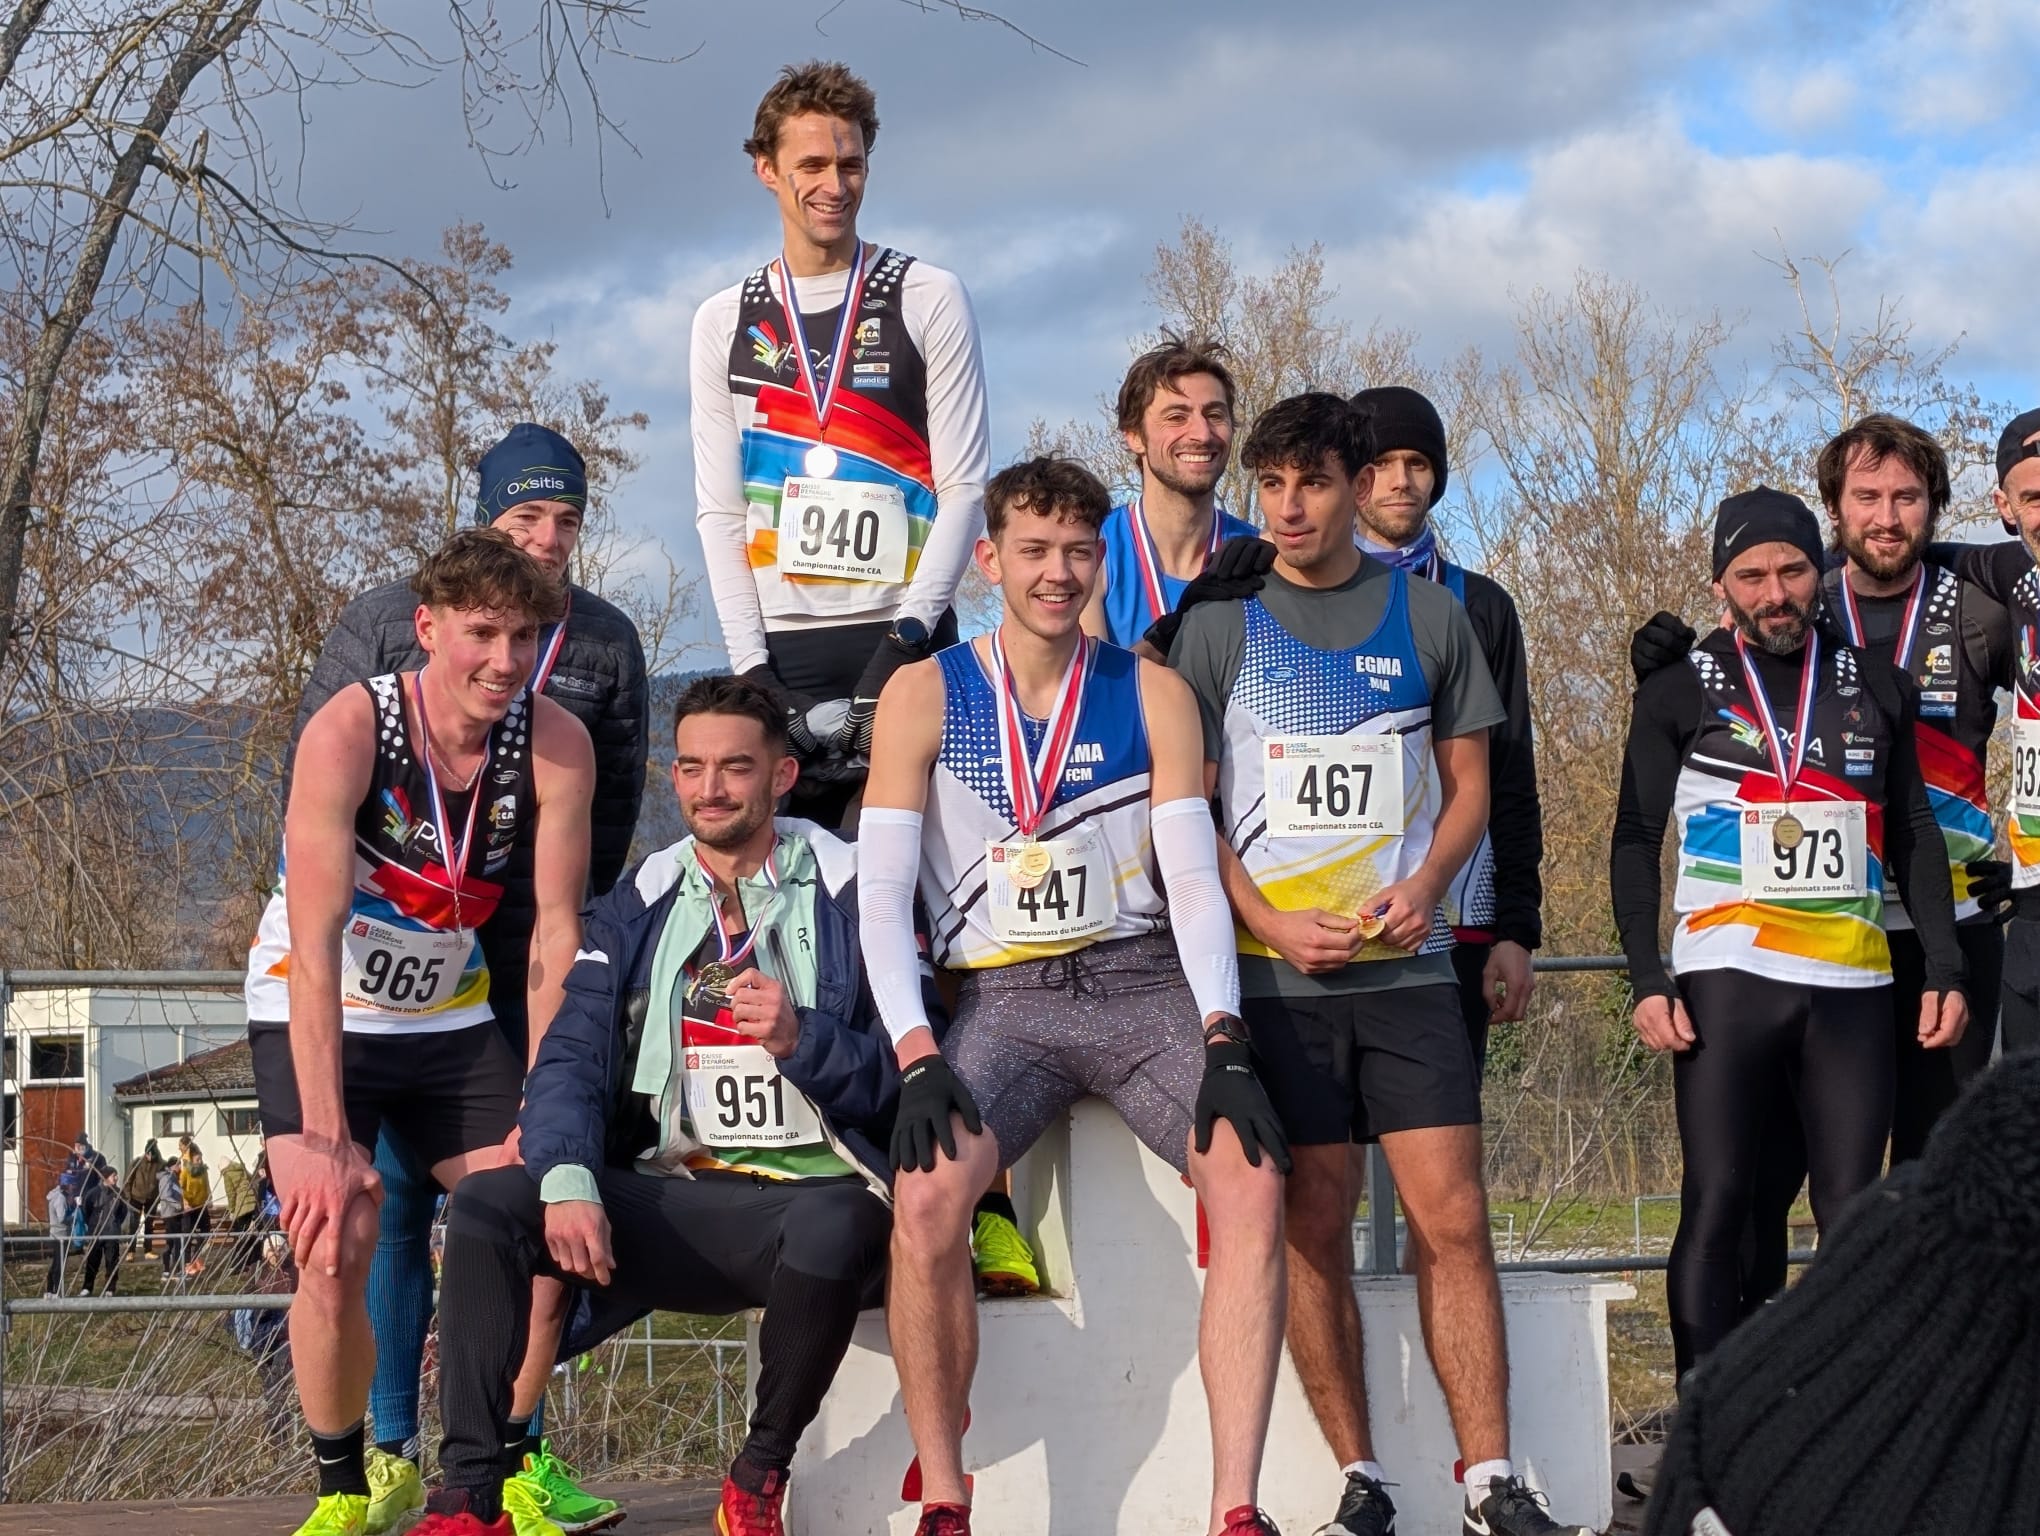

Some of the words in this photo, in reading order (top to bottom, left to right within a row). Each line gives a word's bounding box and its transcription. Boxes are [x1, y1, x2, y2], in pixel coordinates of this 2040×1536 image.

[800, 505, 880, 562] 940
[792, 560, 845, 571] Championnats
[846, 566, 866, 574] zone
[867, 567, 882, 575] CEA
[1355, 655, 1403, 677] EGMA
[1369, 676, 1391, 692] MIA
[1070, 743, 1104, 763] MA
[1065, 767, 1093, 782] FCM
[1296, 763, 1373, 817] 467
[1288, 822, 1346, 833] Championnats
[1347, 822, 1367, 830] zone
[1369, 821, 1384, 829] CEA
[1773, 828, 1844, 880] 973
[1017, 865, 1087, 922] 447
[1763, 884, 1821, 893] Championnats
[1008, 929, 1058, 938] Championnats
[1059, 926, 1070, 935] du
[1071, 919, 1103, 932] Haut-Rhin
[360, 949, 445, 1003] 965
[345, 992, 402, 1013] Championnats
[403, 1006, 421, 1014] zone
[715, 1074, 784, 1128] 951
[709, 1133, 762, 1141] Championnats
[785, 1131, 800, 1140] CEA
